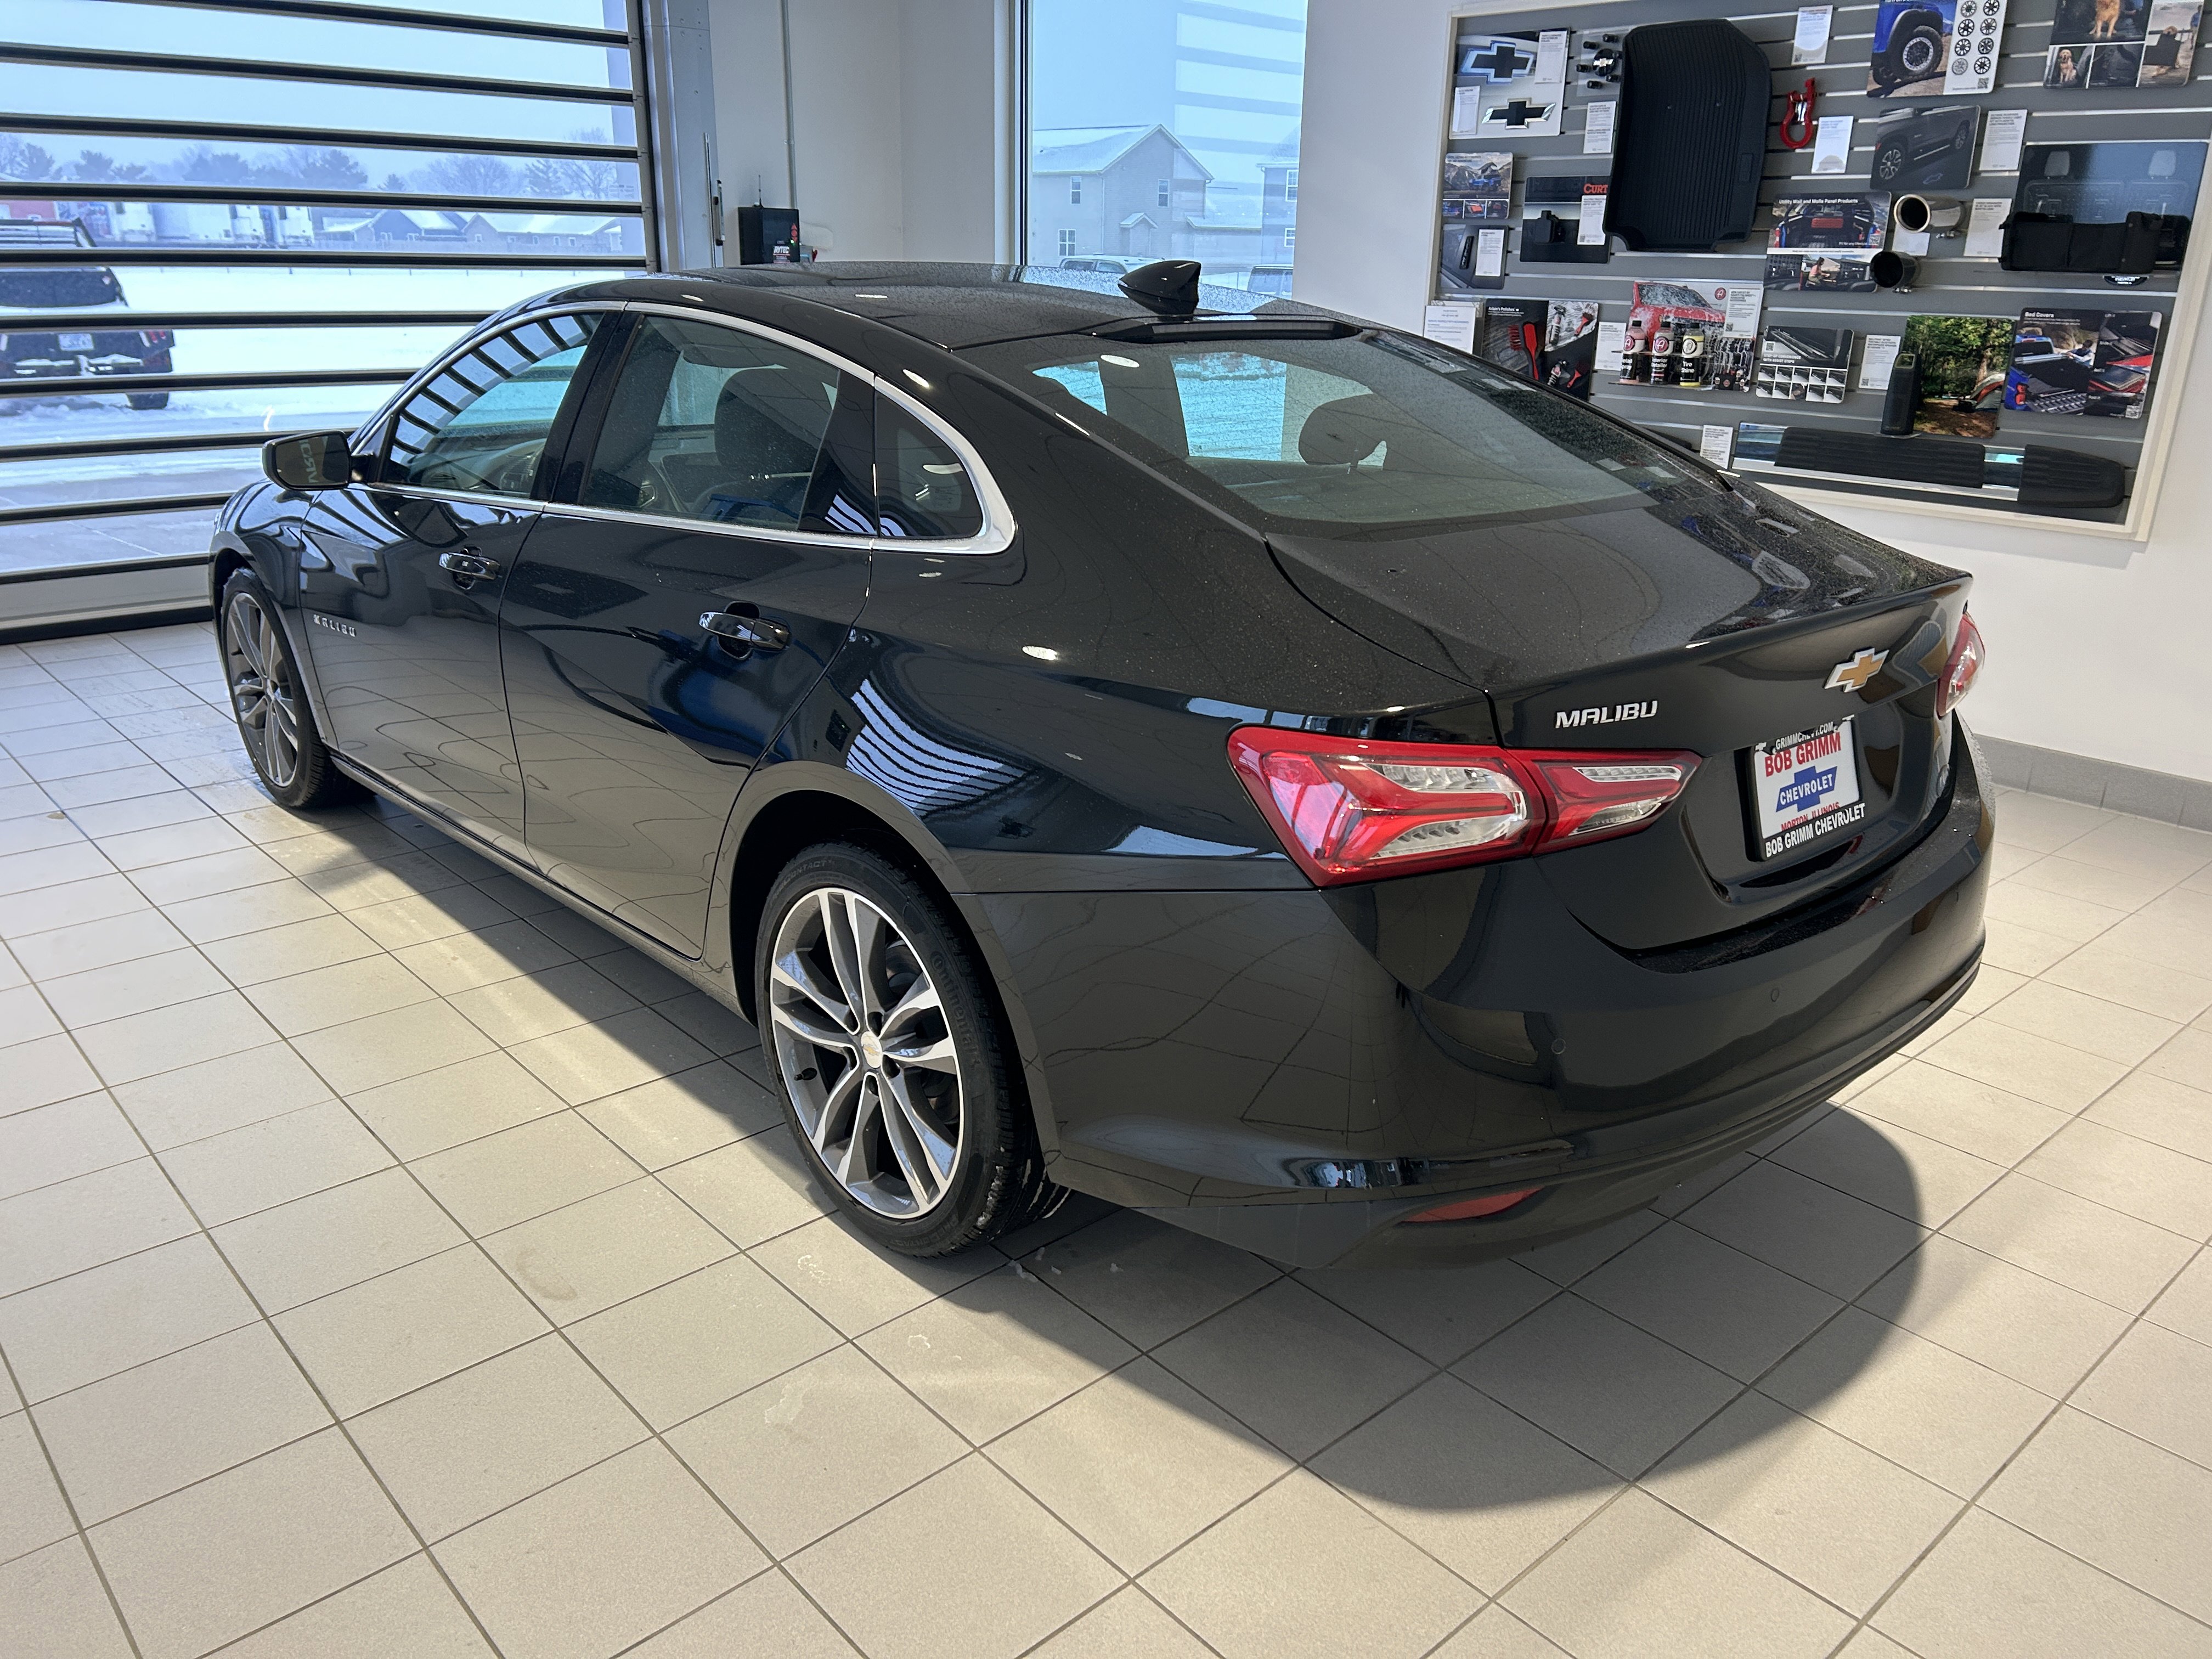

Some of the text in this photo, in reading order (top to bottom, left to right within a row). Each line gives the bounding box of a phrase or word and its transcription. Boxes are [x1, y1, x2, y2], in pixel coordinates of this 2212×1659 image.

[1583, 183, 1609, 194] CURT
[1555, 700, 1658, 729] MALIBU
[1764, 731, 1841, 777] BOB GRIMM
[1780, 774, 1832, 805] CHEVROLET
[1765, 803, 1865, 858] BOB GRIMM CHEVROLET
